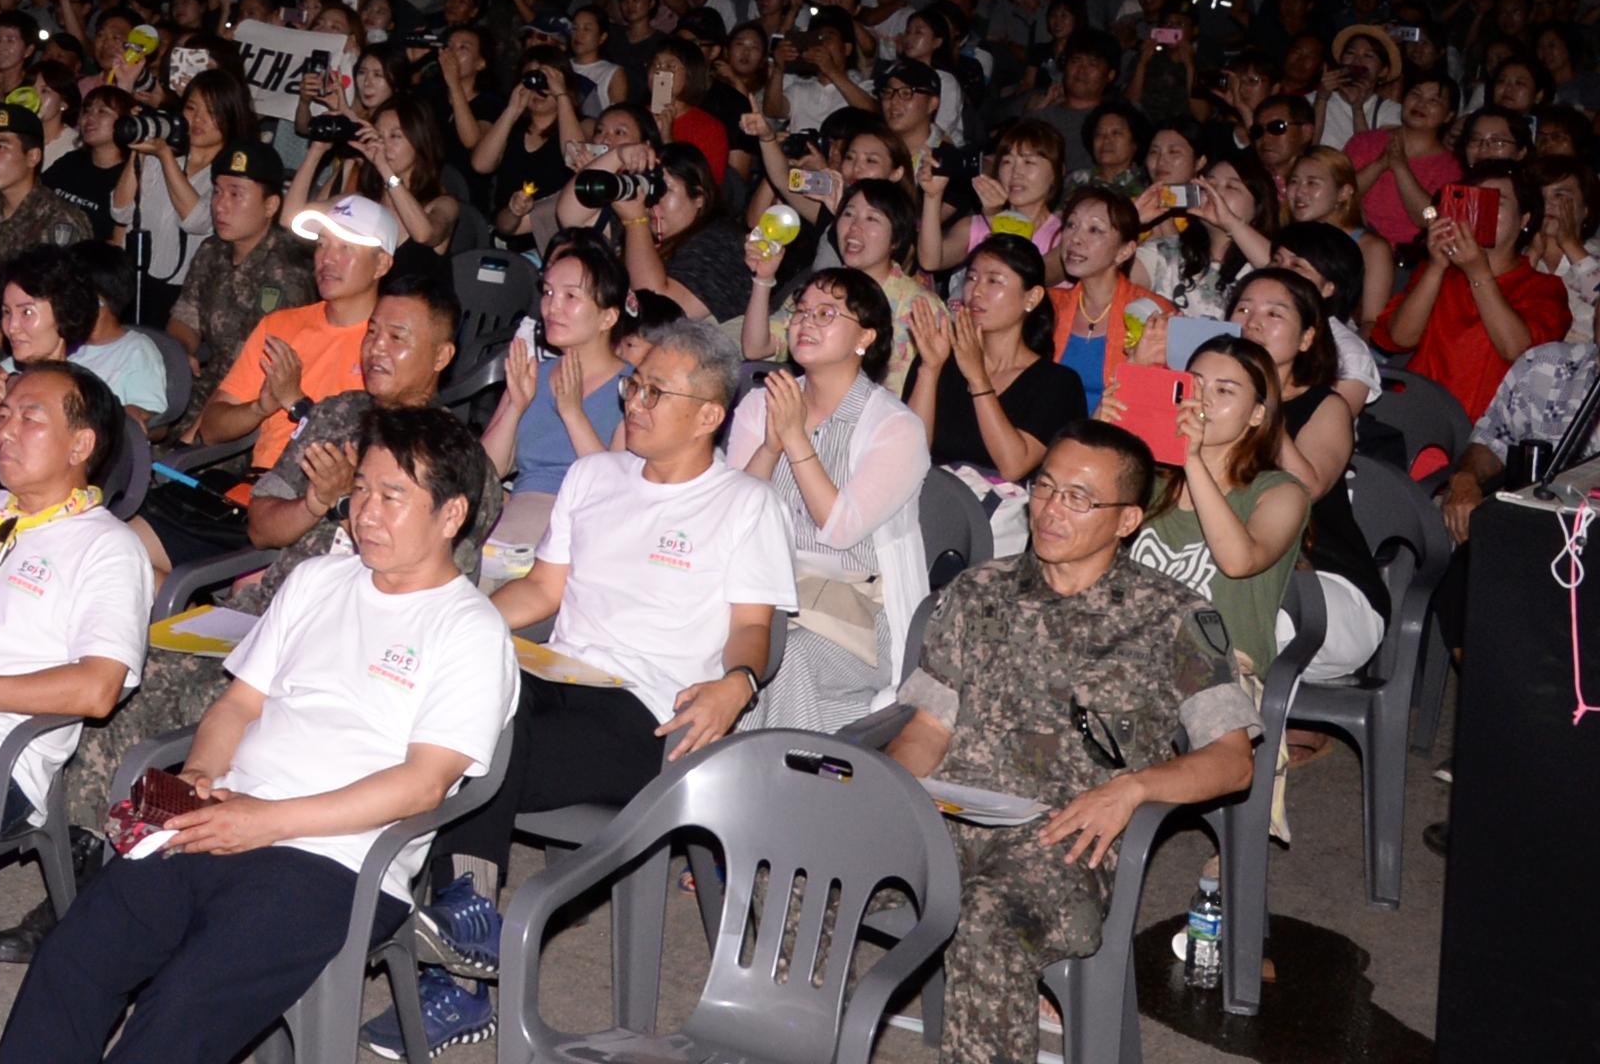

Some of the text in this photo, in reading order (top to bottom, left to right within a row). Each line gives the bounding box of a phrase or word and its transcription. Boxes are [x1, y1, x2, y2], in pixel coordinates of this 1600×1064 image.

[656, 536, 687, 553] 토마토
[17, 560, 46, 580] 토마토
[379, 648, 414, 671] 토마토
